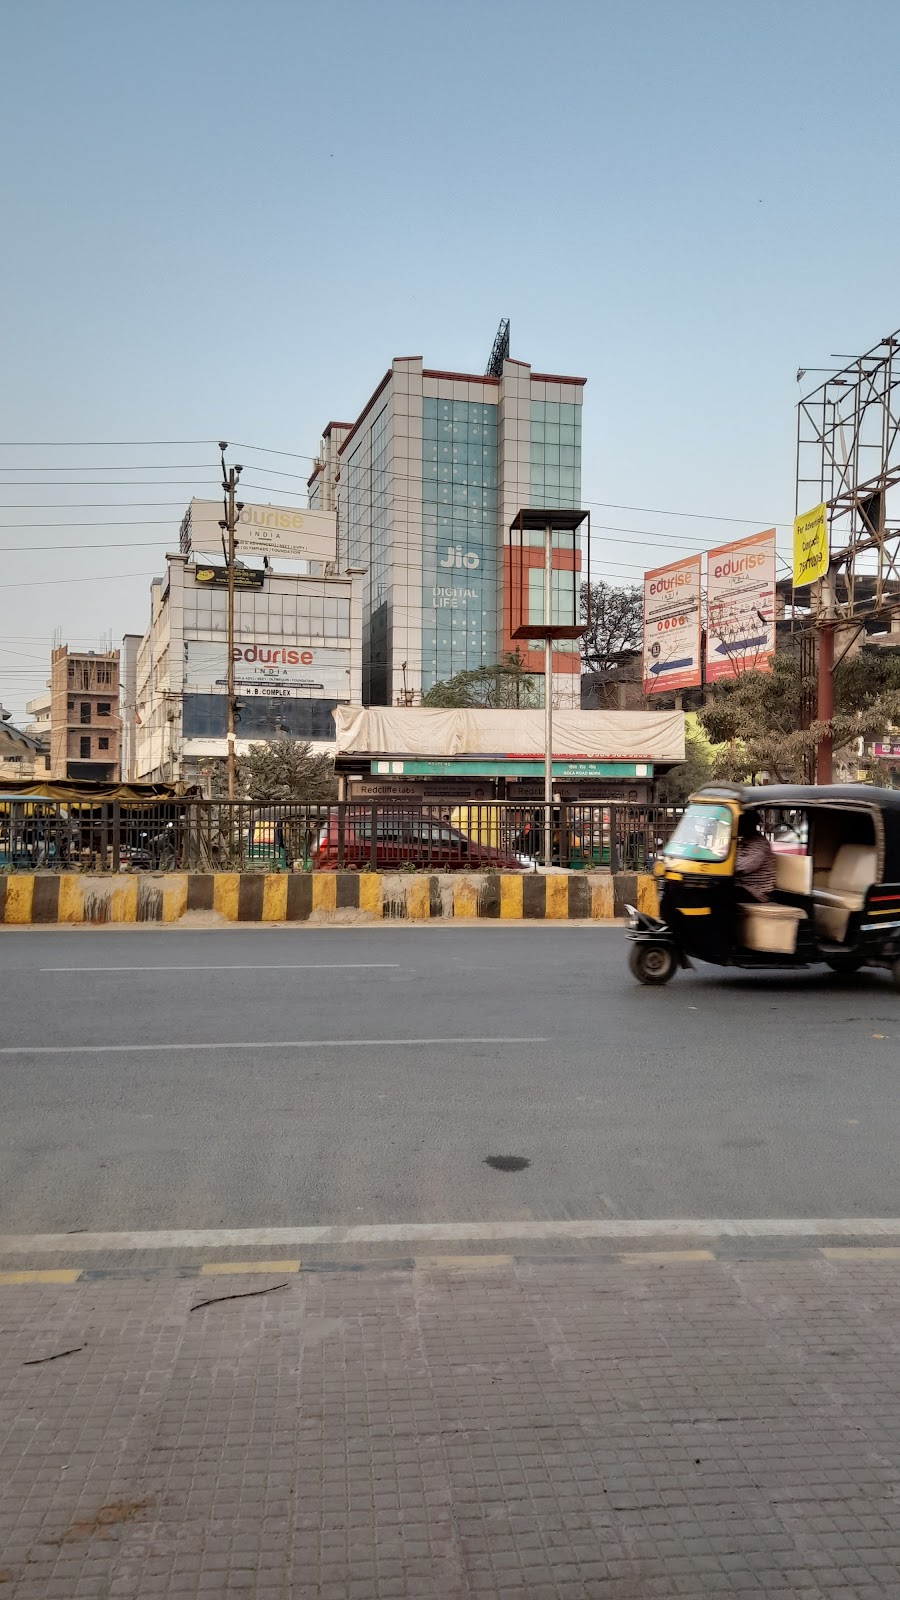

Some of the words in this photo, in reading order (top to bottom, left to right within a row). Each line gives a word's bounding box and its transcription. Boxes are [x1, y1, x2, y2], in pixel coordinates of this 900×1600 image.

[235, 507, 304, 528] durise
[249, 531, 281, 539] INDIA
[440, 545, 480, 569] Jio
[714, 552, 765, 578] edurise
[432, 587, 479, 598] DIGITAL
[649, 573, 691, 595] edurise
[432, 597, 458, 608] LIFE
[232, 644, 313, 664] edurise
[361, 785, 398, 794] Redcliffe
